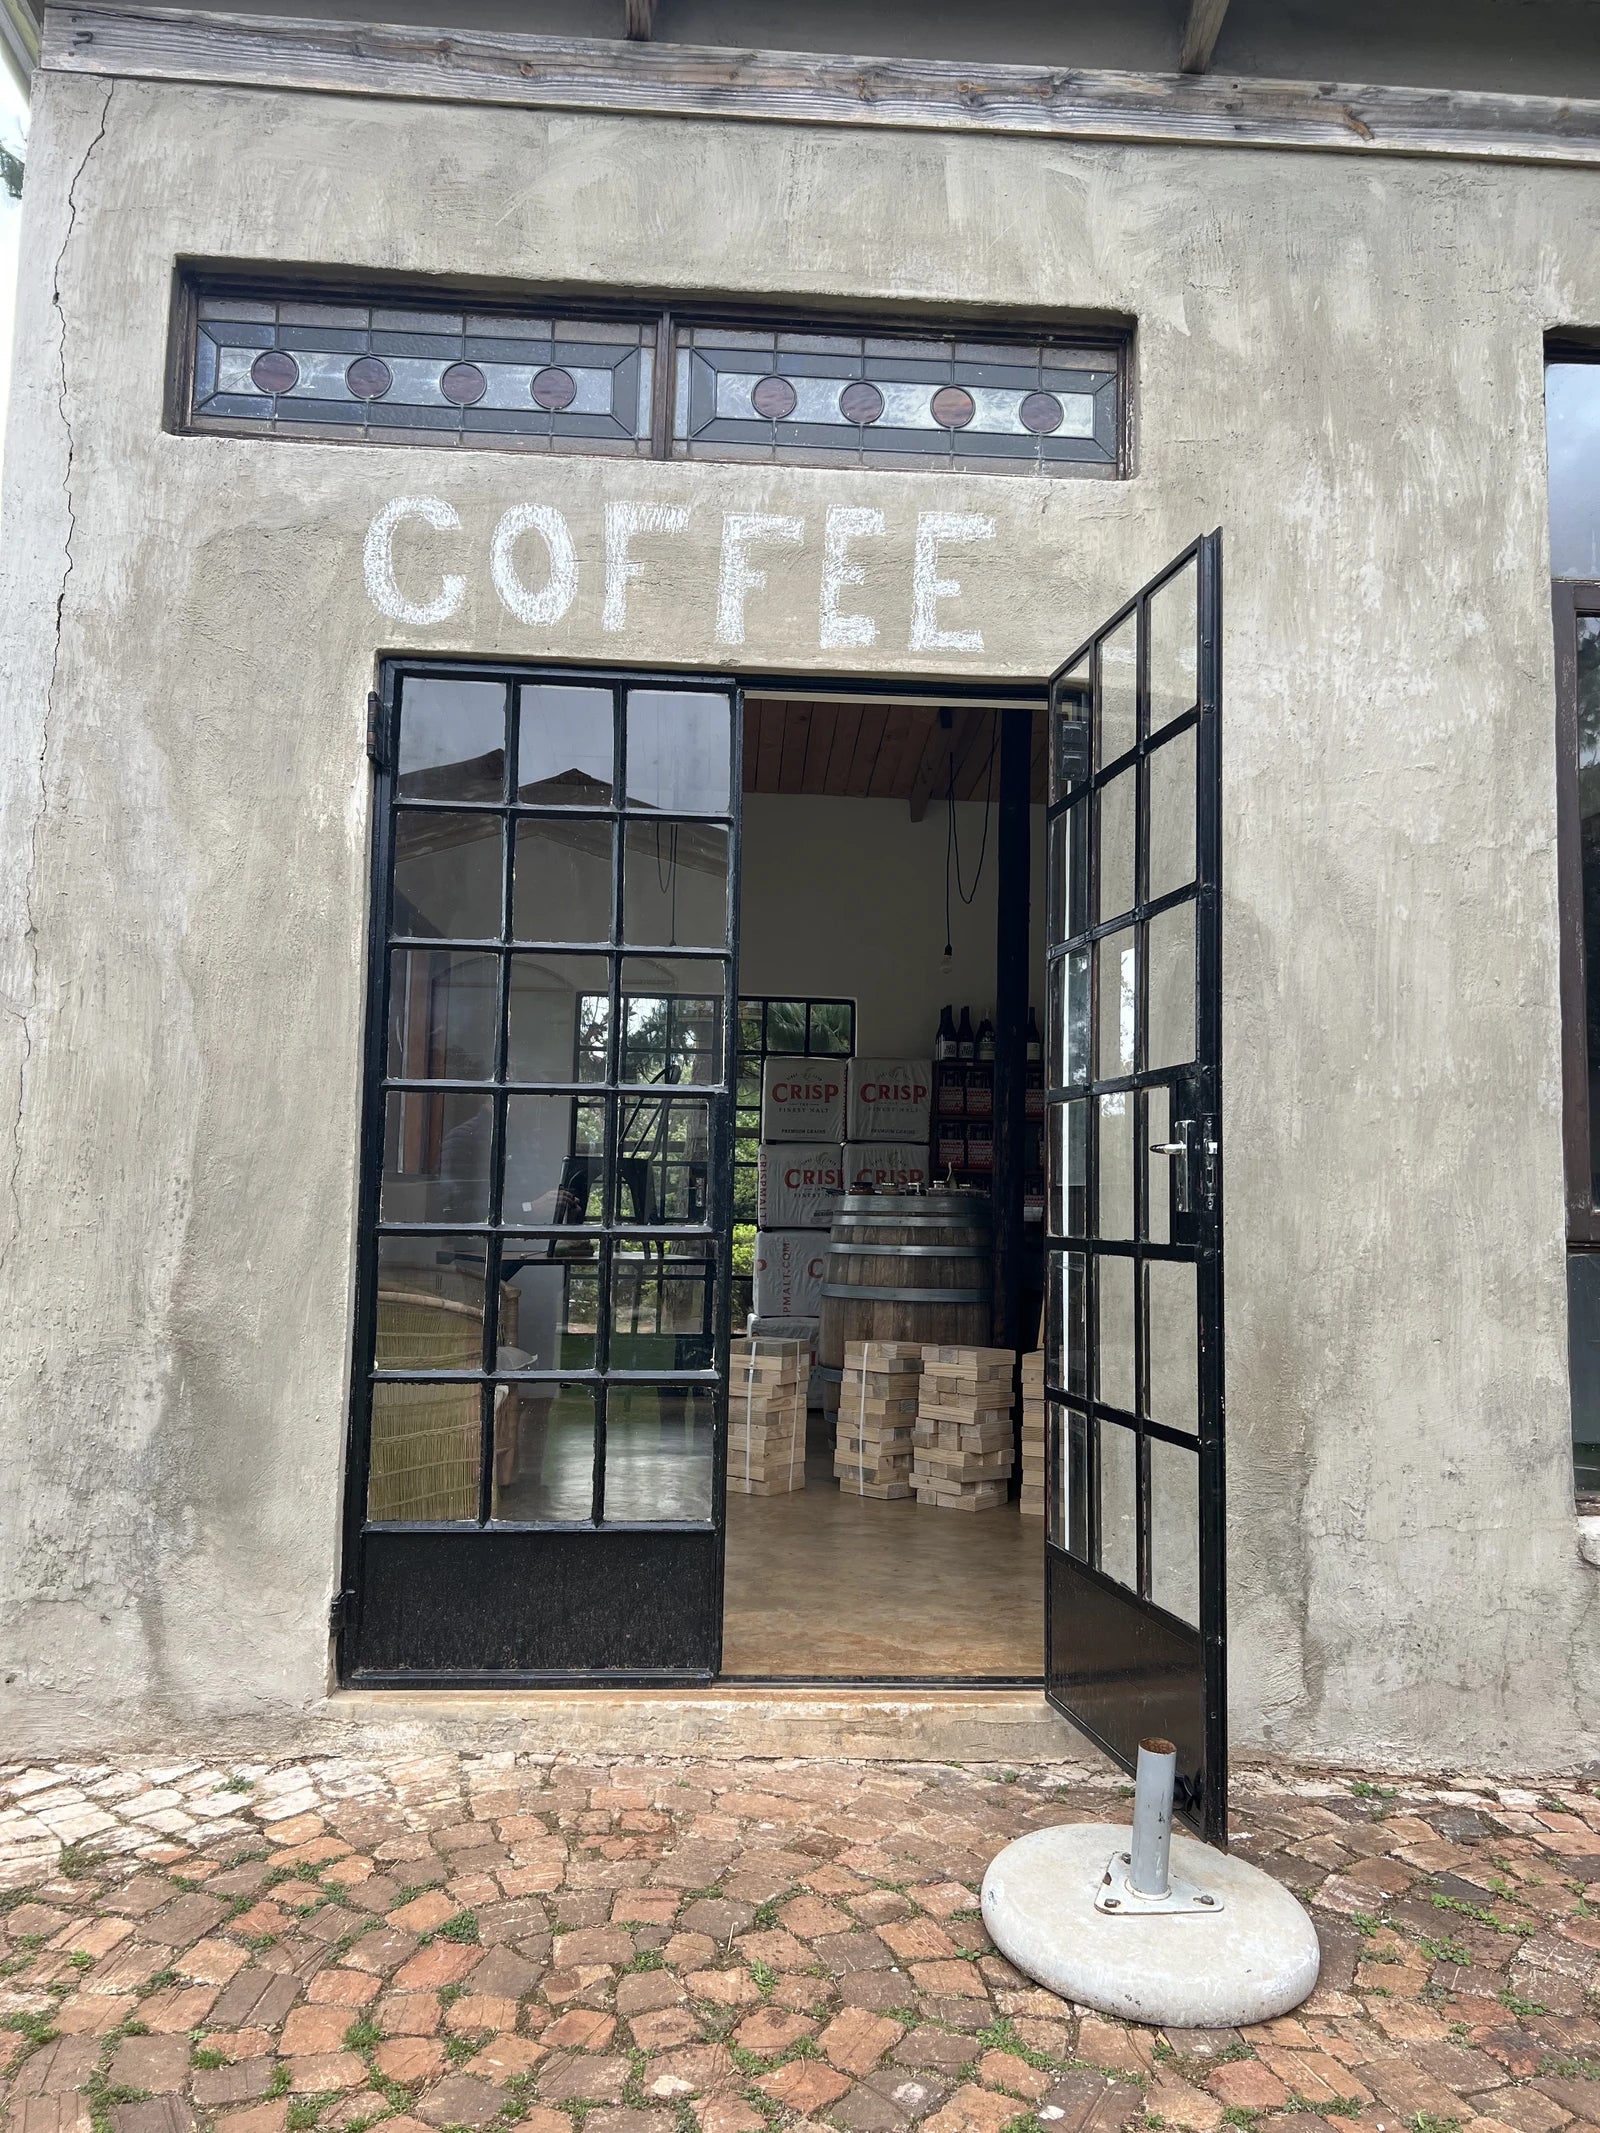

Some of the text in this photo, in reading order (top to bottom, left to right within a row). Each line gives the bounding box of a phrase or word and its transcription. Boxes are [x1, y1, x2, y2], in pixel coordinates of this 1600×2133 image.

[363, 495, 996, 652] COFFEE
[771, 1083, 839, 1104] CRISP
[860, 1083, 928, 1104] CRISP
[856, 1168, 924, 1185] CRISP
